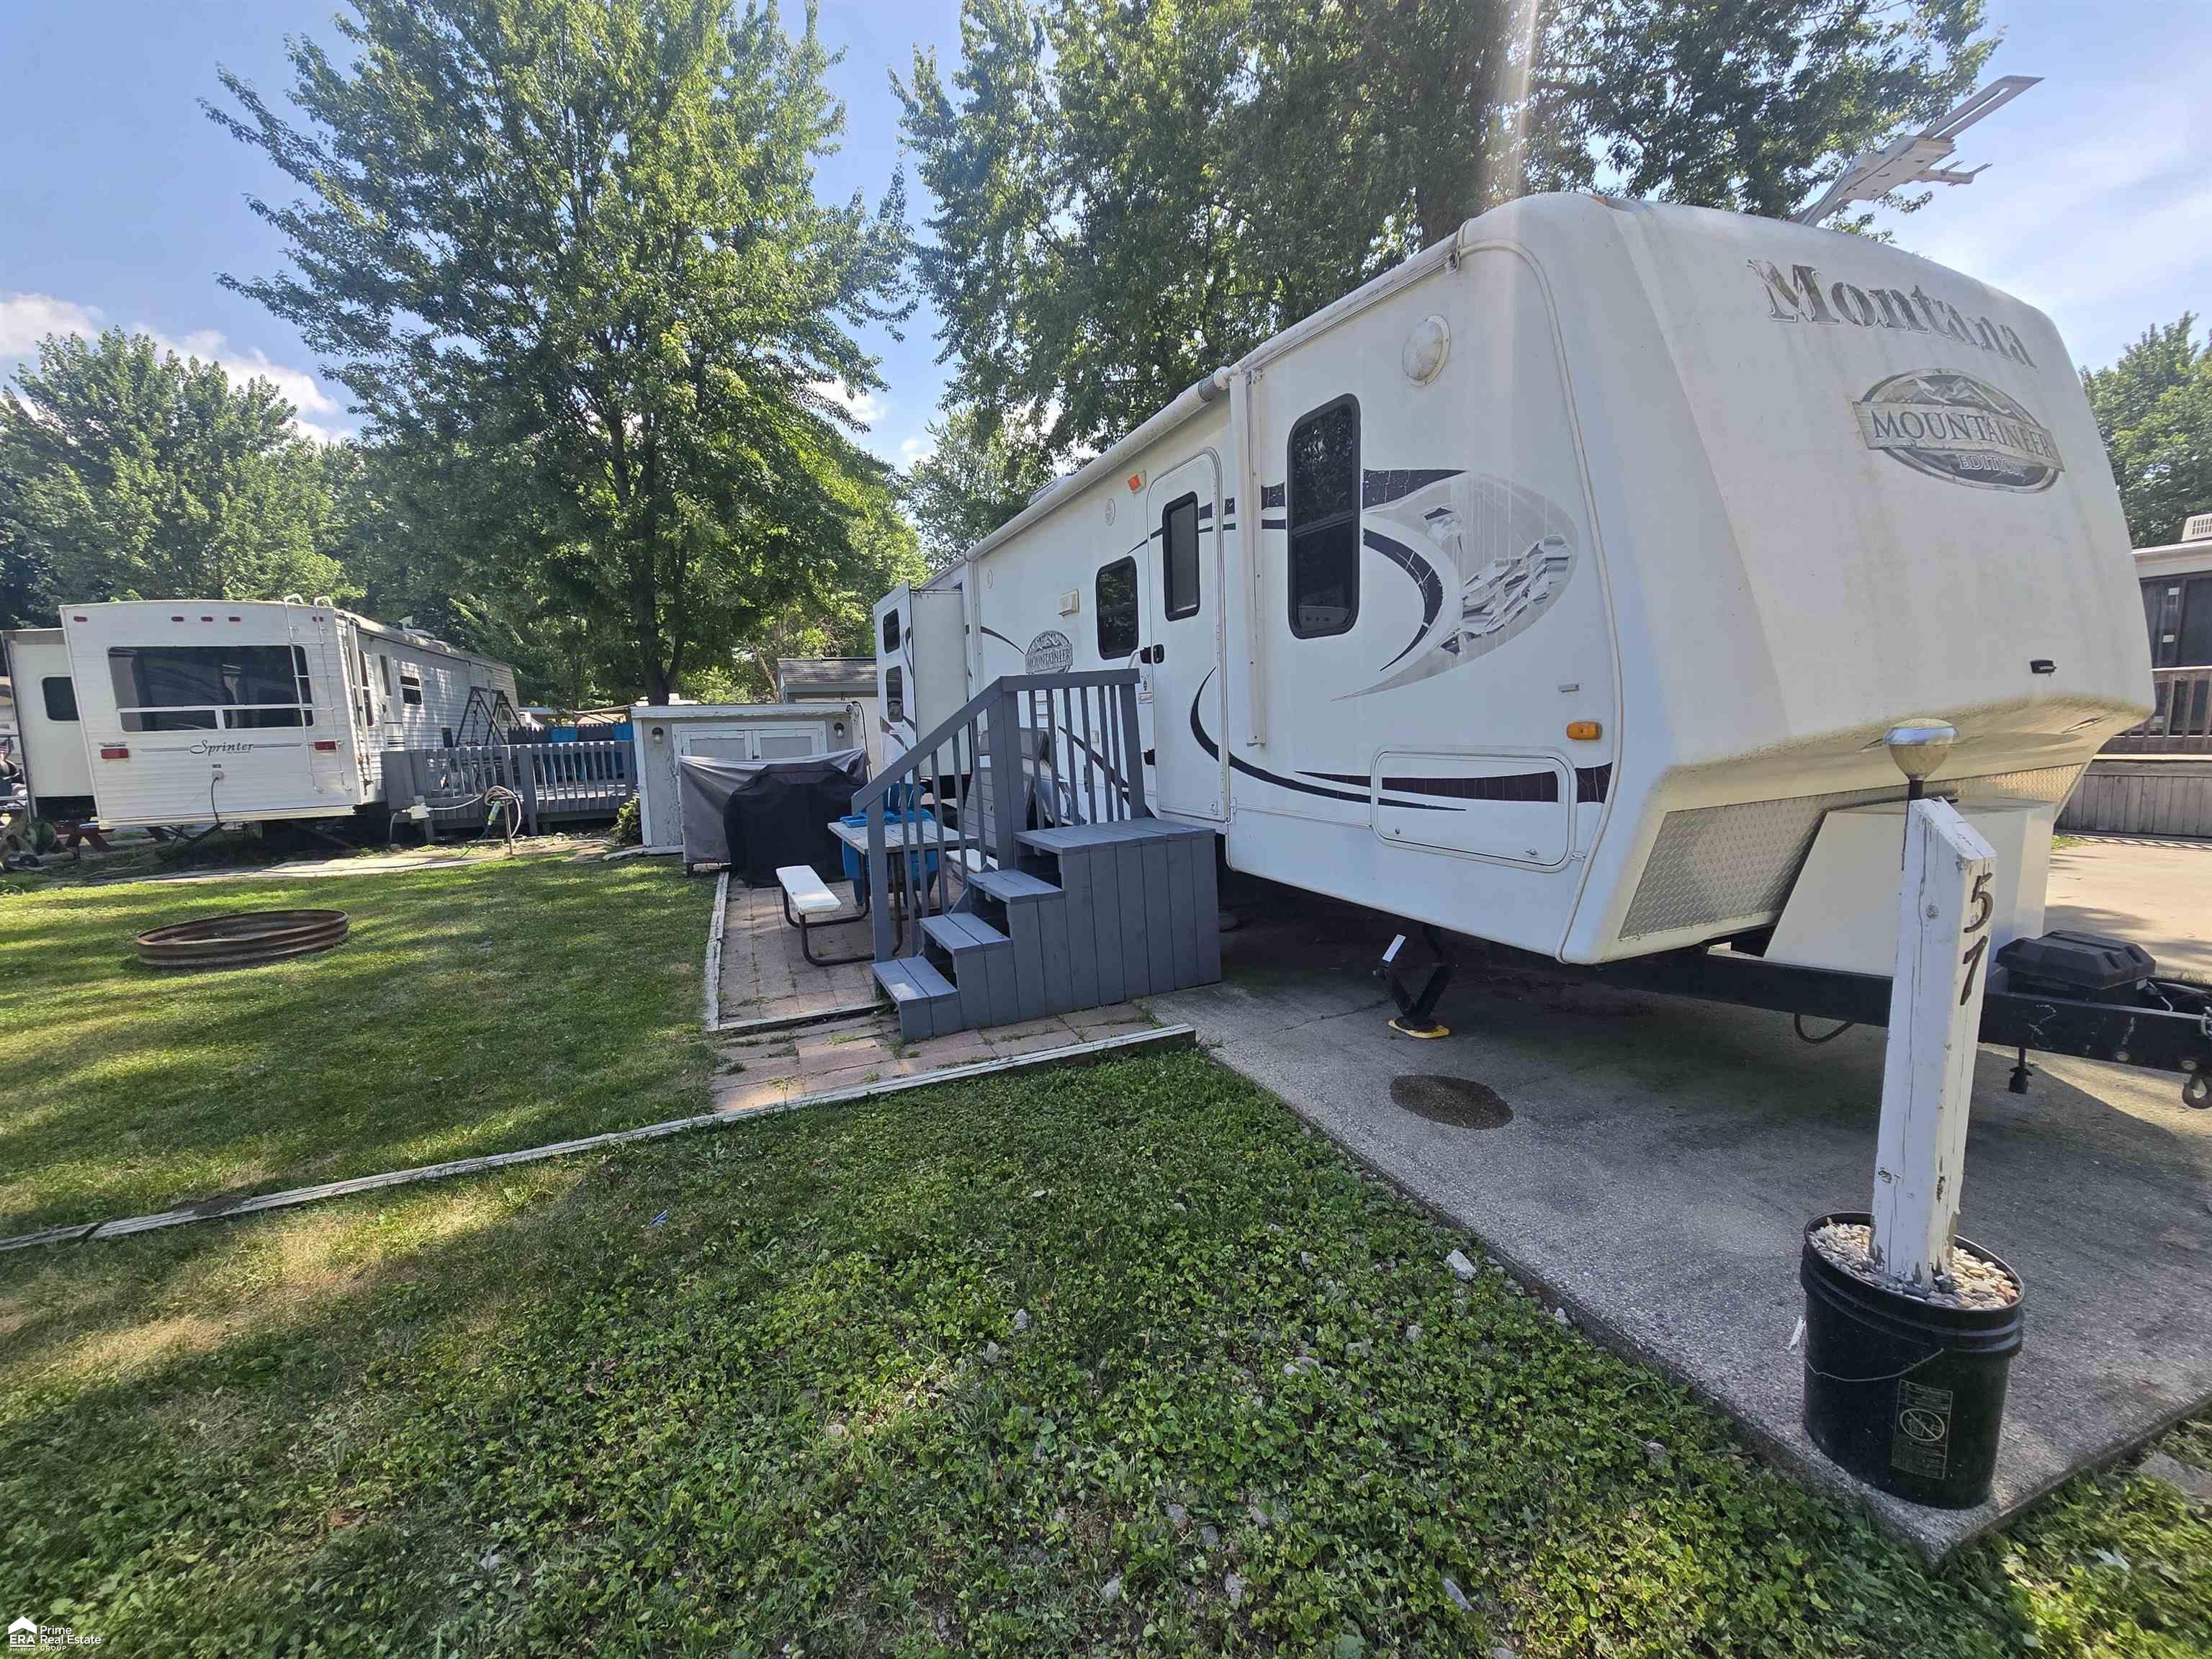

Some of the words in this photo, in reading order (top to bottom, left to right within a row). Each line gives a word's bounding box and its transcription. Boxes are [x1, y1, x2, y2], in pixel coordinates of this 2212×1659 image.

[1746, 259, 2037, 369] Montana
[1871, 410, 2058, 461] MOUNTAINEER
[190, 739, 253, 756] Sprinter
